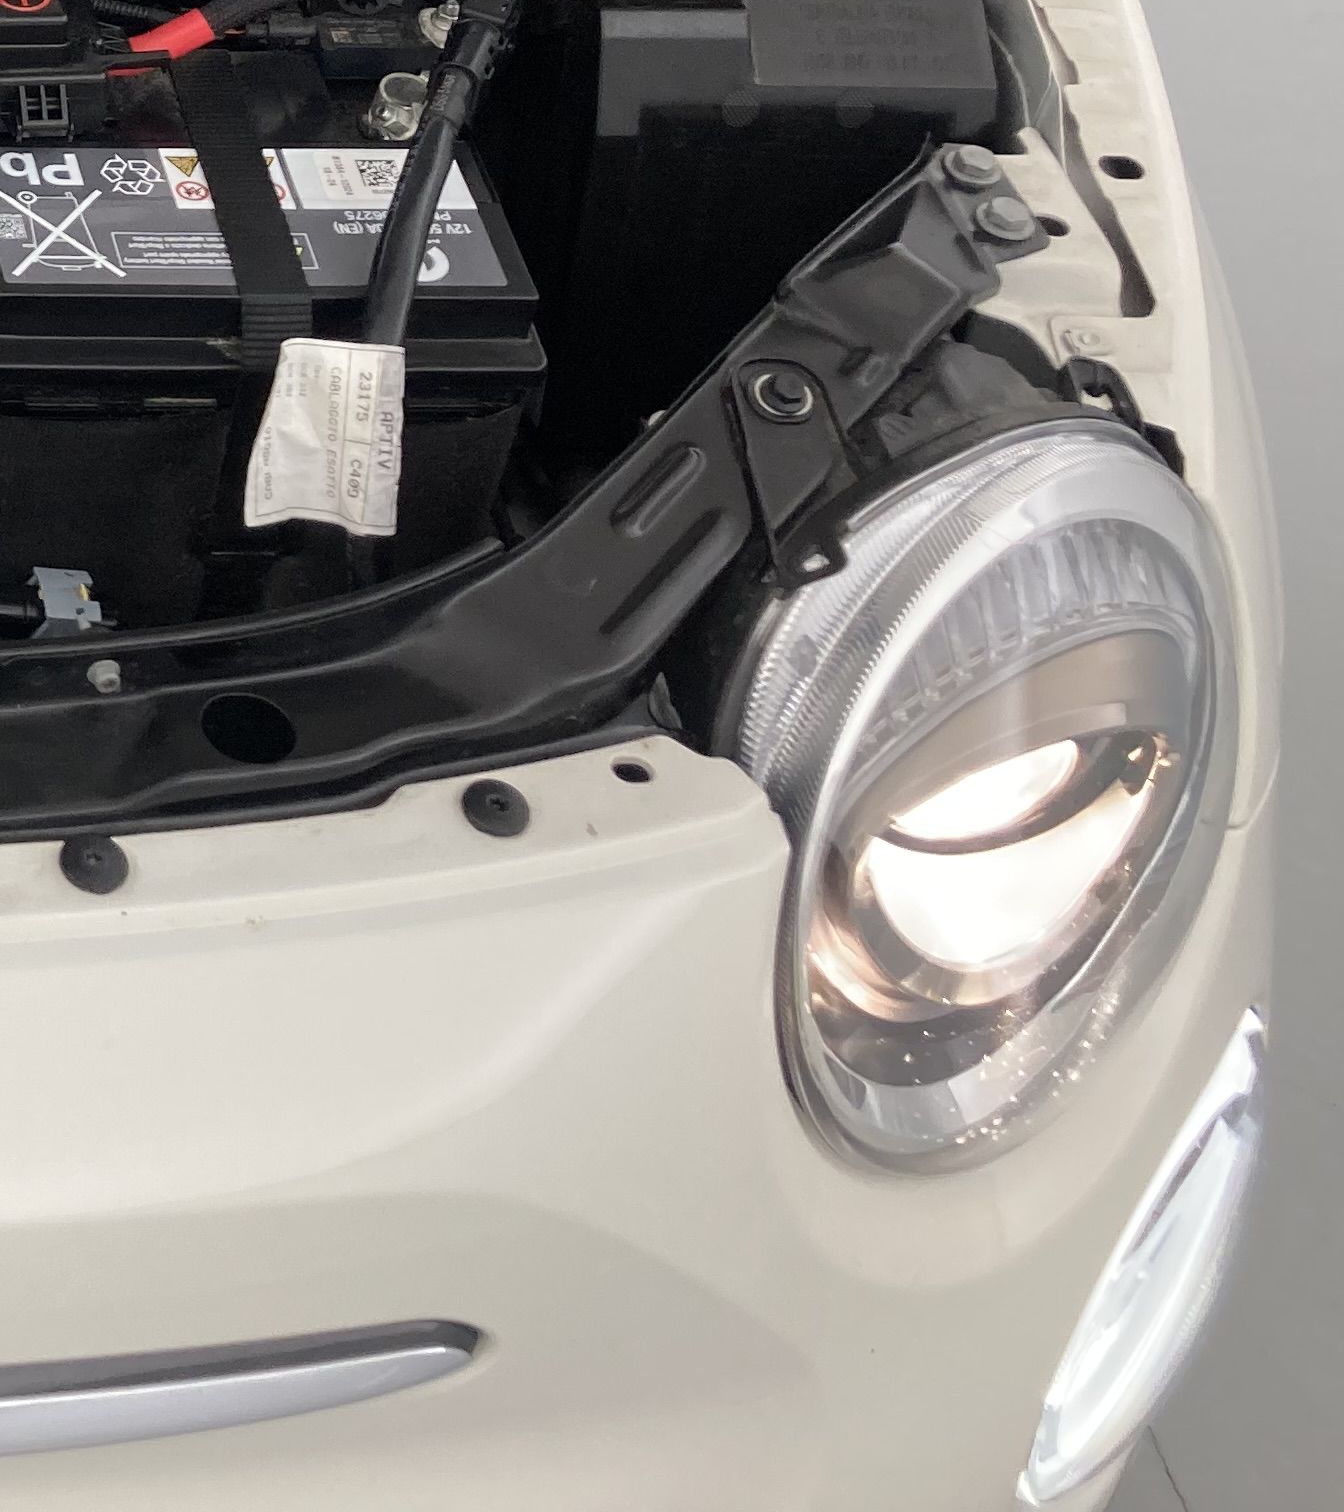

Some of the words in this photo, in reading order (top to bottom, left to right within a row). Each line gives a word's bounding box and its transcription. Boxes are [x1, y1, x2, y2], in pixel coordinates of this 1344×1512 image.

[333, 220, 364, 235] (EN)
[445, 223, 472, 235] 12V
[355, 371, 374, 423] 23175
[376, 410, 395, 470] APTIV
